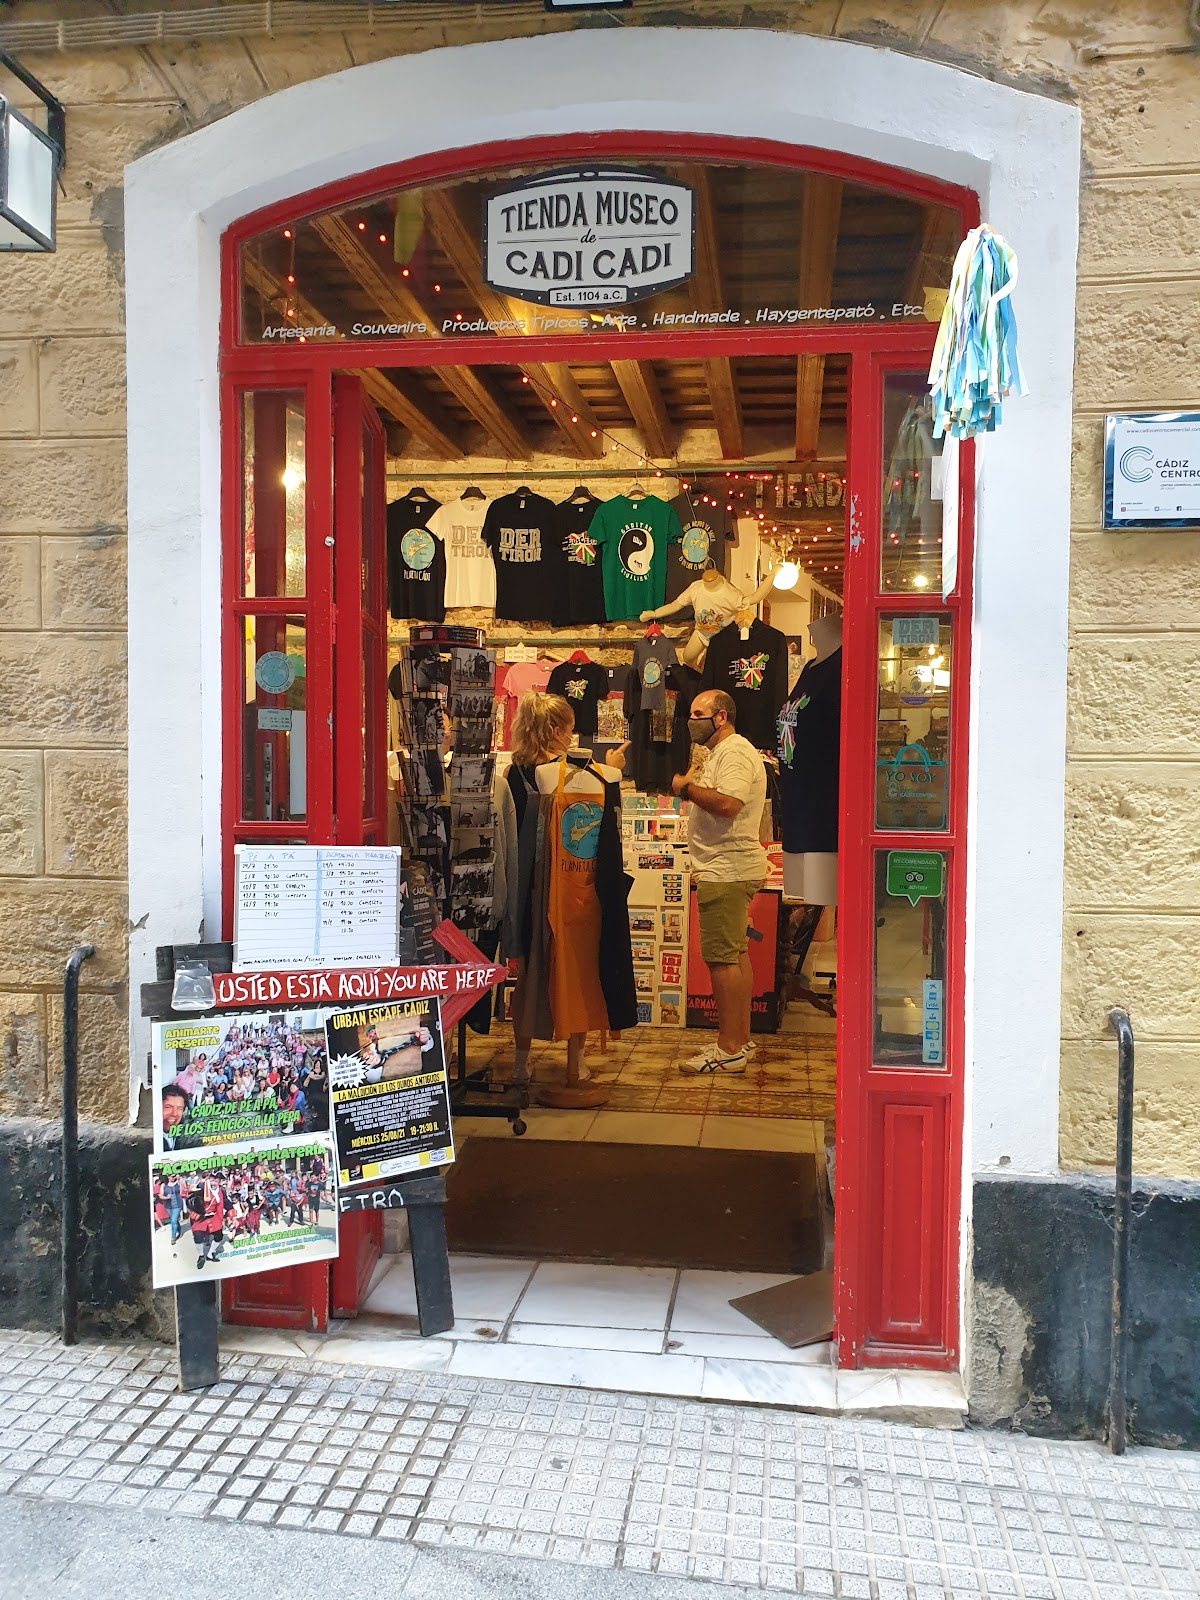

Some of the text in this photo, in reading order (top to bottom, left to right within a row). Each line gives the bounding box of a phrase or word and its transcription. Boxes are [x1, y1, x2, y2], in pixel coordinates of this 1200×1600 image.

[500, 190, 679, 233] TIENDA MUSEO
[580, 228, 597, 244] de
[505, 242, 672, 281] CADI CADI
[556, 290, 623, 302] Est. 1104 a.C.
[262, 321, 337, 339] Artesanía
[351, 320, 427, 336] Souvenirs
[442, 316, 525, 333] Productos
[529, 315, 589, 331] Típicos
[602, 313, 637, 327] Arte
[652, 309, 740, 325] Handmade
[755, 302, 875, 326] Haygentepató
[1155, 458, 1189, 468] CÁDIZ
[500, 527, 542, 548] DER
[499, 547, 542, 562] TIRON
[900, 620, 934, 634] DER
[900, 634, 934, 643] TIRON
[886, 770, 936, 784] YO SOY
[219, 973, 282, 1002] USTED
[287, 972, 332, 998] ESTÁ
[419, 970, 449, 991] ARE
[455, 968, 497, 989] HERE
[333, 1011, 367, 1030] URBAN
[368, 1005, 402, 1025] ESCAPE
[338, 1092, 347, 1101] LA
[378, 1086, 386, 1094] DE
[386, 1083, 396, 1092] LOS
[415, 1073, 440, 1085] ANTIGUOS
[191, 1102, 223, 1118] CÁDIZ
[224, 1101, 238, 1115] DE
[239, 1094, 253, 1112] PÉ
[253, 1099, 262, 1112] A
[169, 1110, 300, 1138] DE LOS FENICIOS A LA PEPA
[202, 1134, 222, 1143] RUTA
[351, 1132, 380, 1148] MIÉRCOLES
